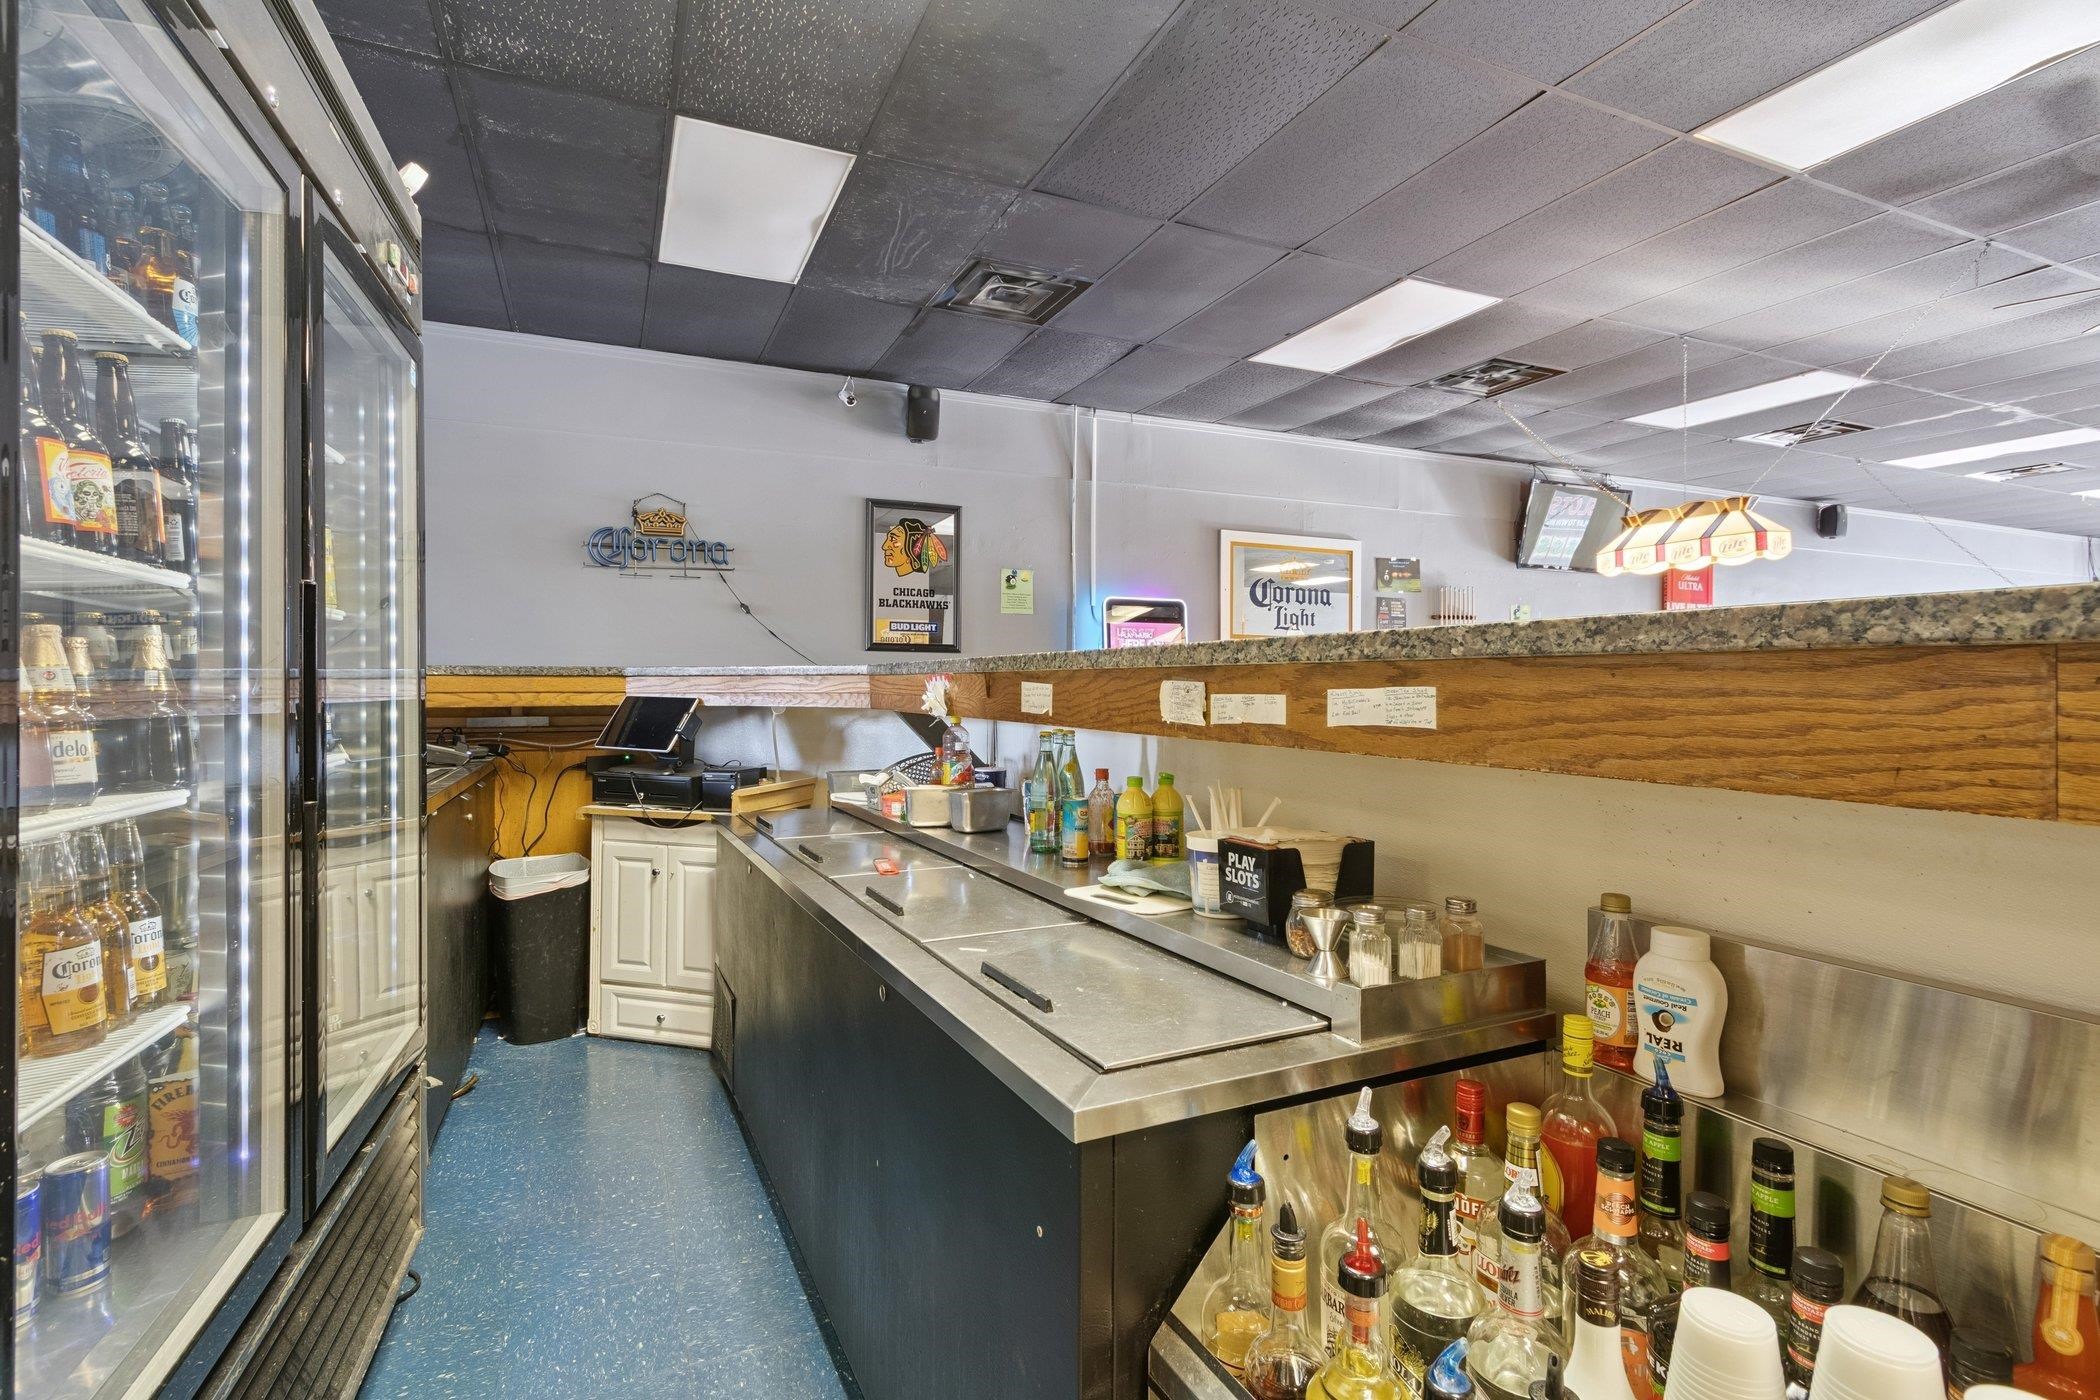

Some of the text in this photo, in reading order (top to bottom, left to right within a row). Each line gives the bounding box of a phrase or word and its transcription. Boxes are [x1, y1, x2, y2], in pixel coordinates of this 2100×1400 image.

[588, 526, 729, 569] Corona
[1678, 581, 1704, 592] ULTRA
[893, 588, 935, 598] CHICAGO
[1249, 578, 1332, 611] Corona
[879, 599, 949, 610] BLACKHAWKS
[1273, 605, 1316, 630] Light
[890, 622, 937, 631] BUD LIGHT
[53, 740, 87, 758] delo
[1228, 852, 1256, 872] PLAY
[1225, 867, 1260, 889] SLOTS
[1590, 1006, 1611, 1018] PEACH
[1671, 1003, 1687, 1012] Real
[1648, 1141, 1670, 1150] APPLE
[1755, 1191, 1779, 1204] APPLE
